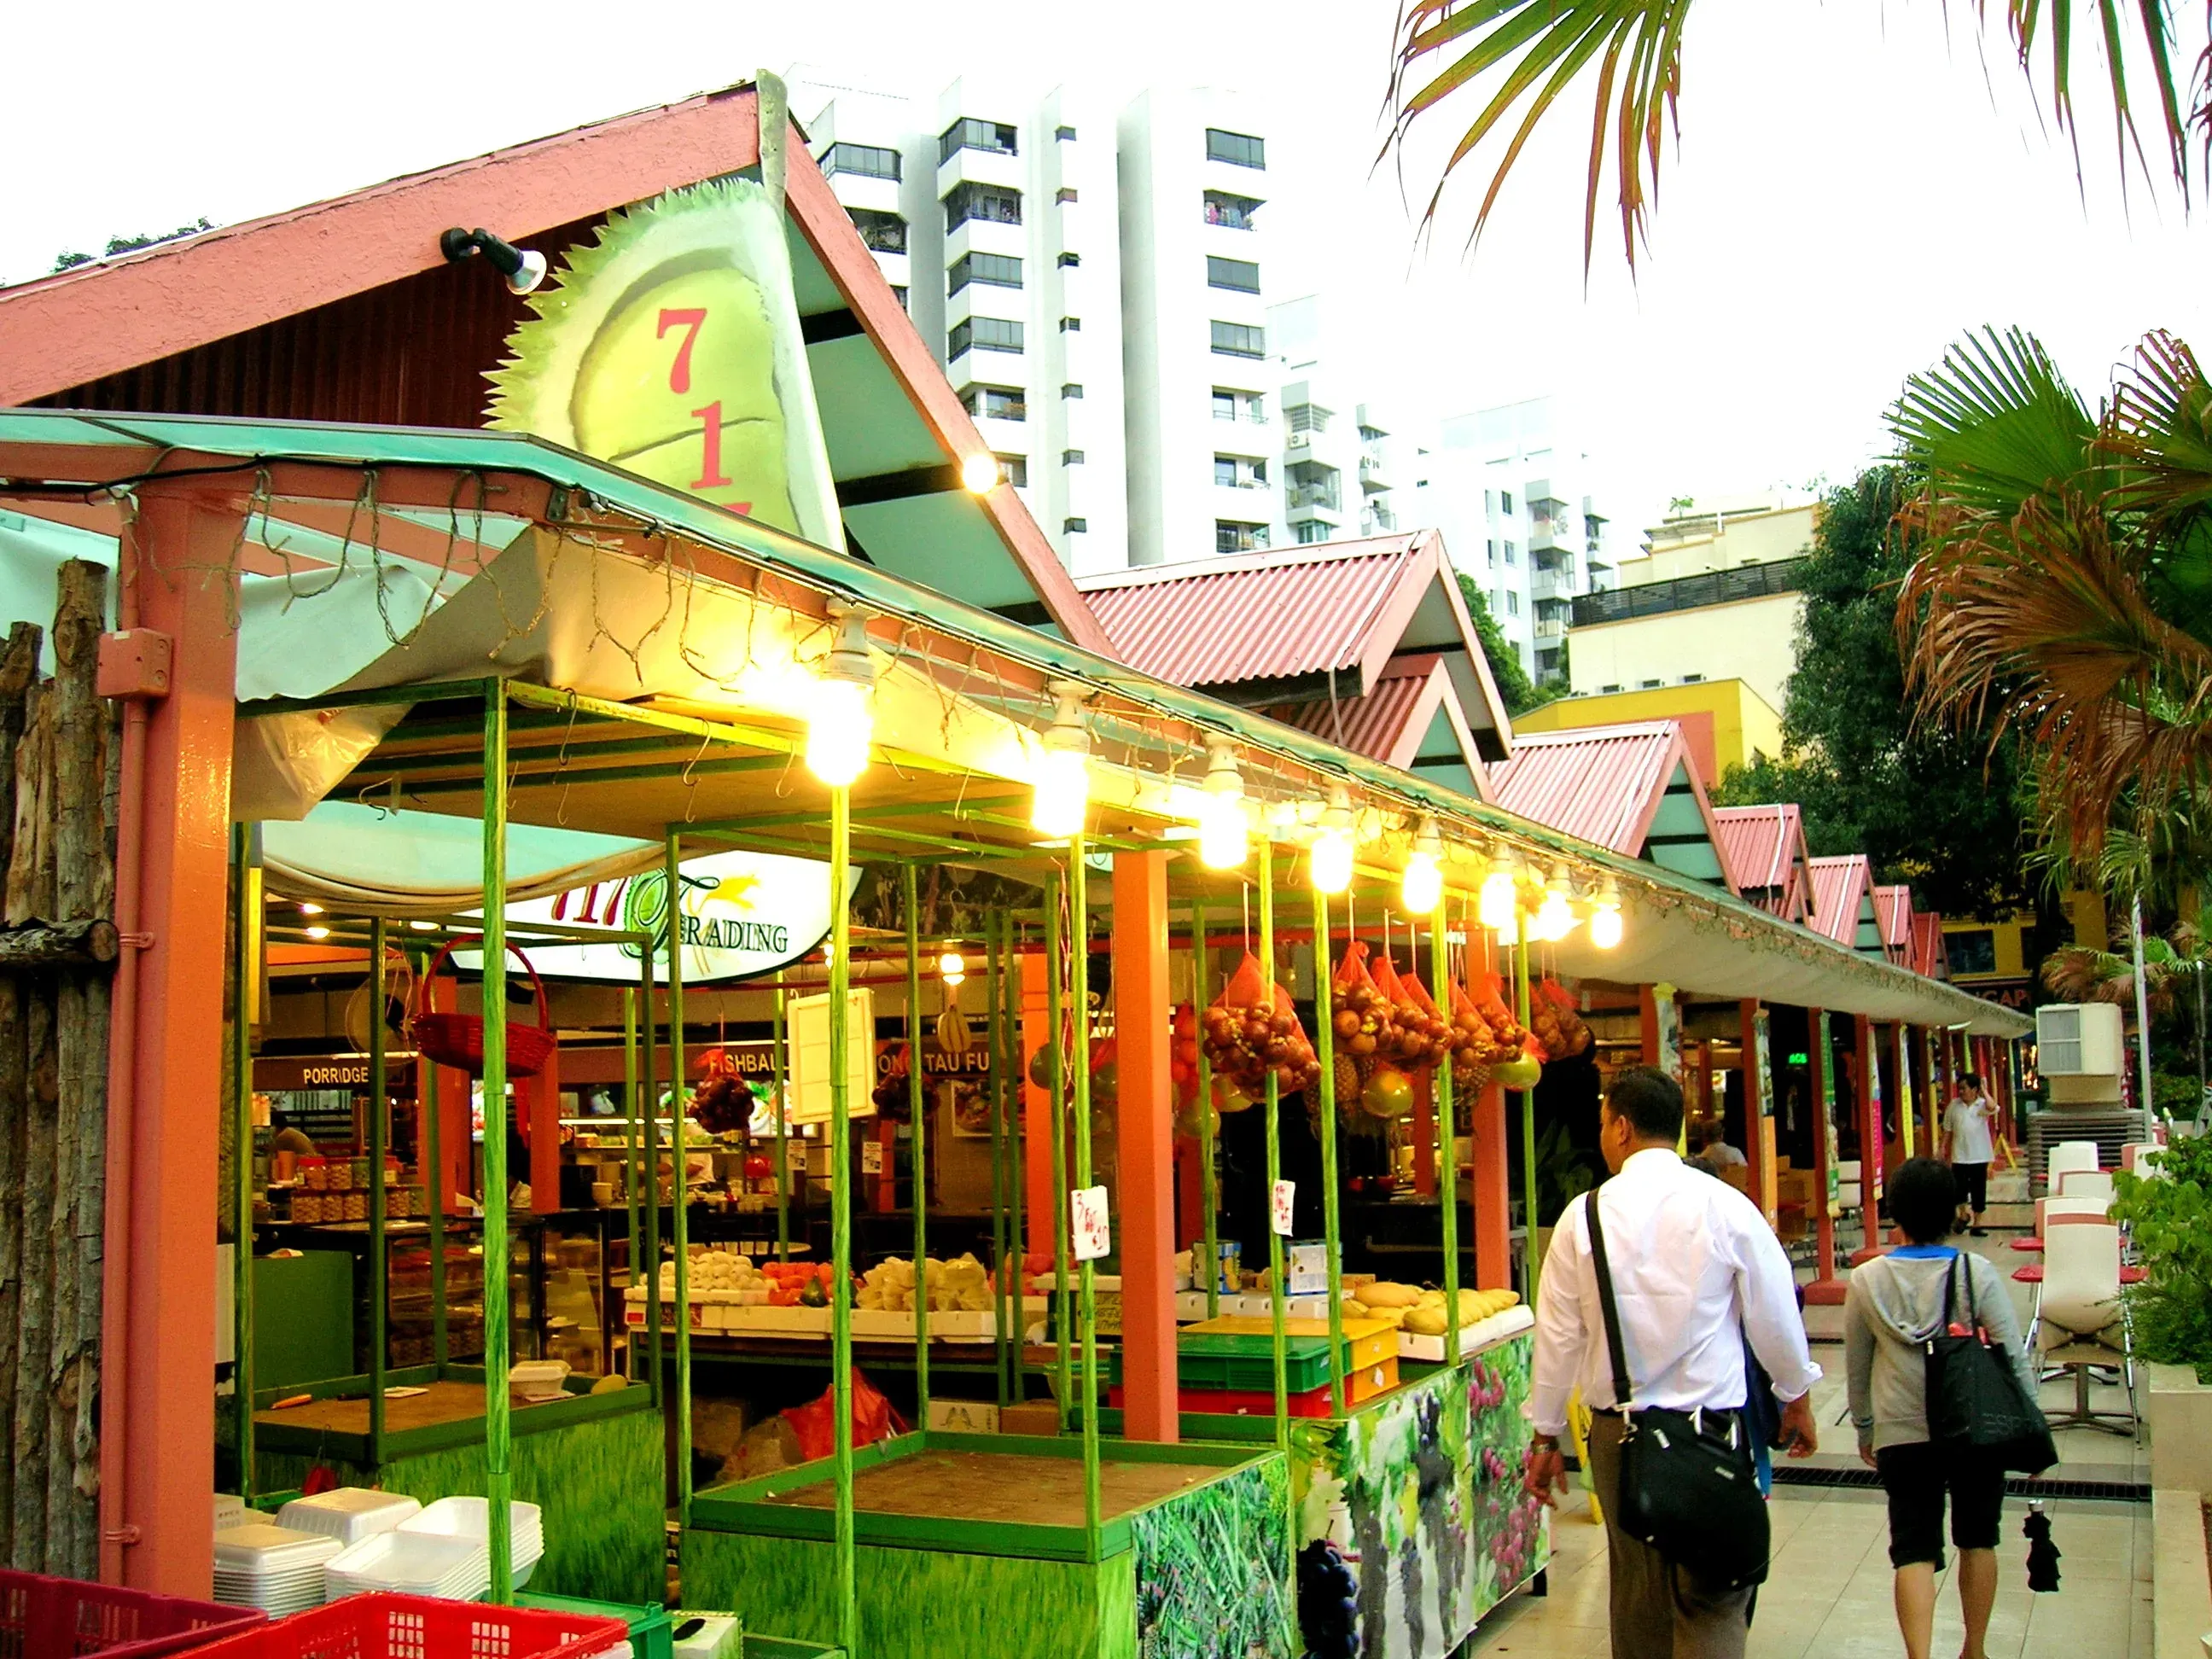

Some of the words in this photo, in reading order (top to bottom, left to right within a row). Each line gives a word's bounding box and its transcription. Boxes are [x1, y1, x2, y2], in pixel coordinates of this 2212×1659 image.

[655, 307, 753, 516] 71
[924, 1052, 960, 1073] TAU
[966, 1051, 990, 1072] FU
[303, 1066, 369, 1085] PORRIDGE
